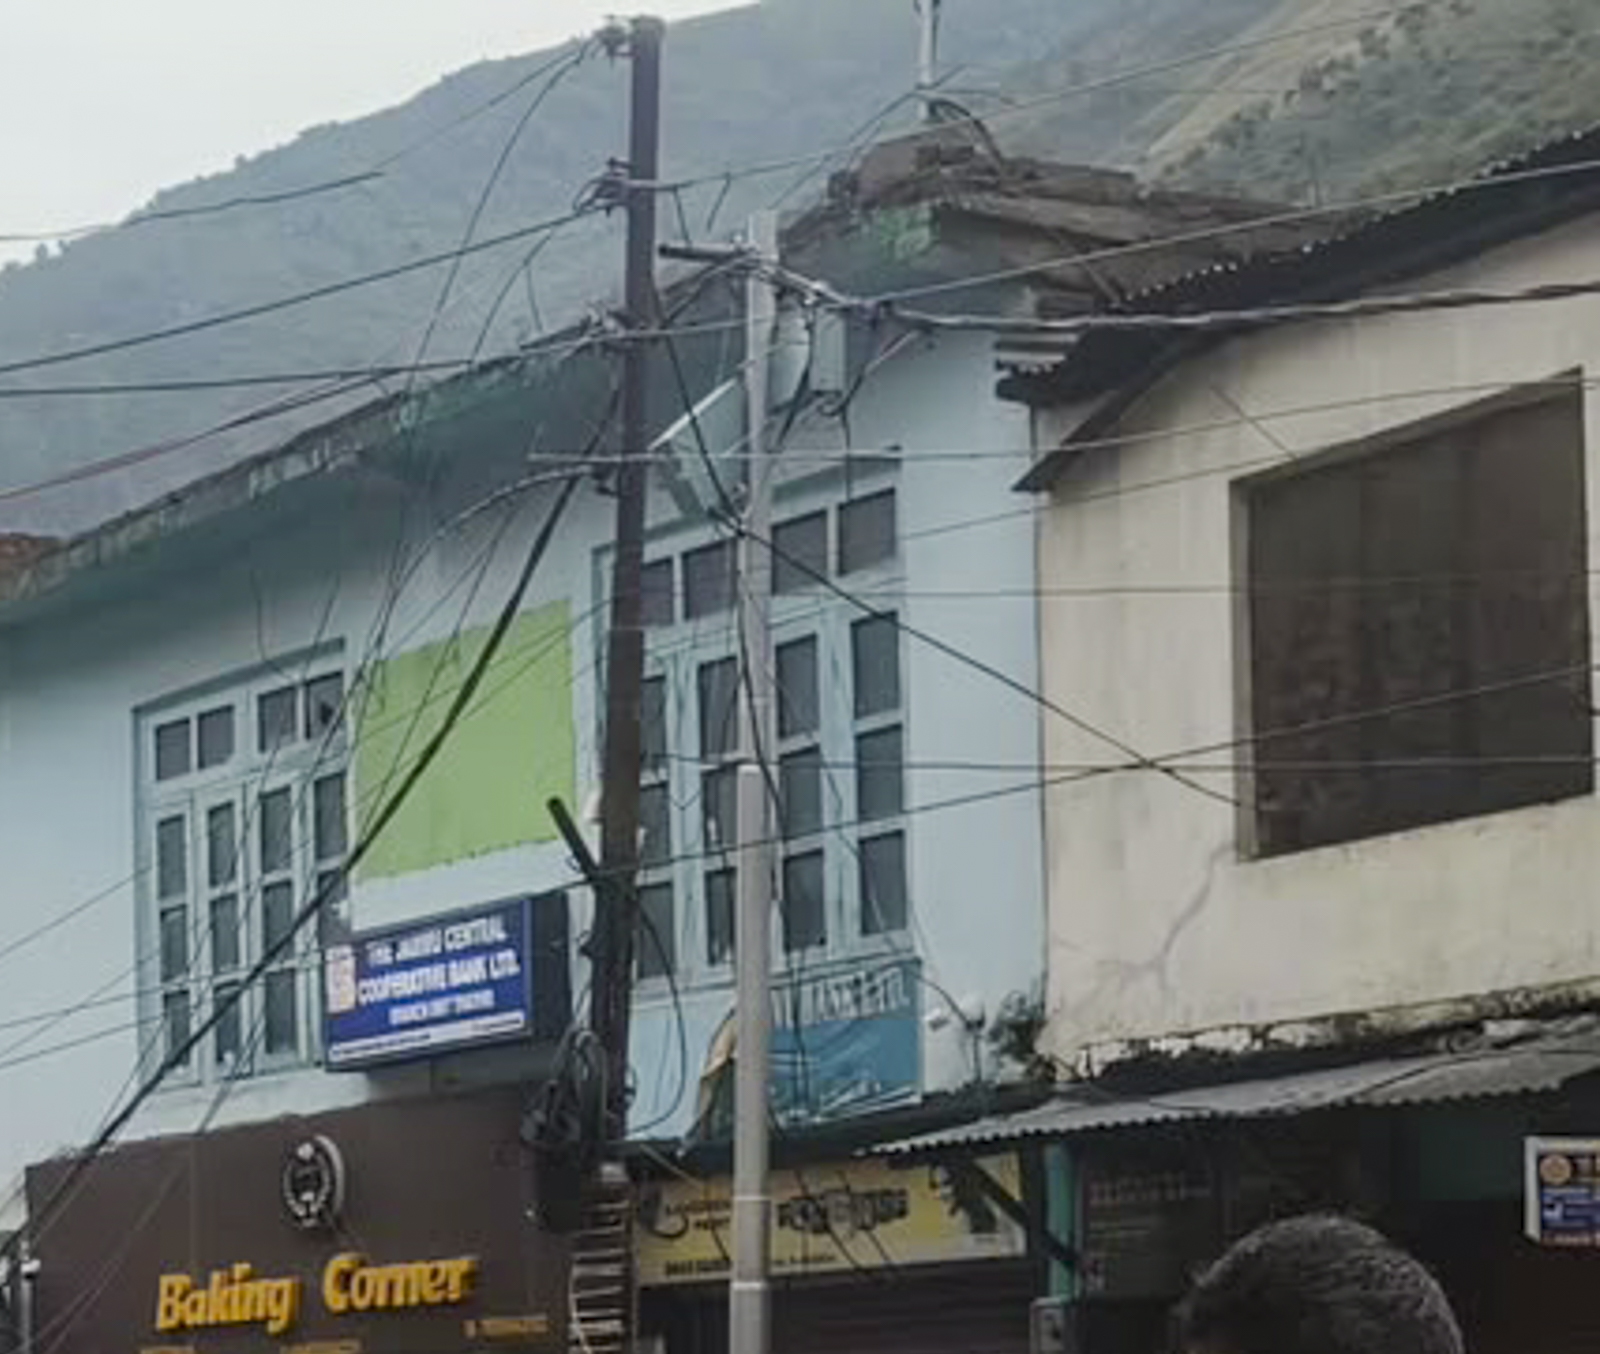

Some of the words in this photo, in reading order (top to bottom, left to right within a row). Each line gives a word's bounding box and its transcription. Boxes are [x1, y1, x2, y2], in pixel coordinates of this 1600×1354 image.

[445, 914, 507, 951] CENTRAL
[358, 963, 446, 1005] COOPERATIVE
[448, 956, 487, 988] BANK
[156, 1262, 296, 1335] Baking
[323, 1253, 477, 1314] Corner
